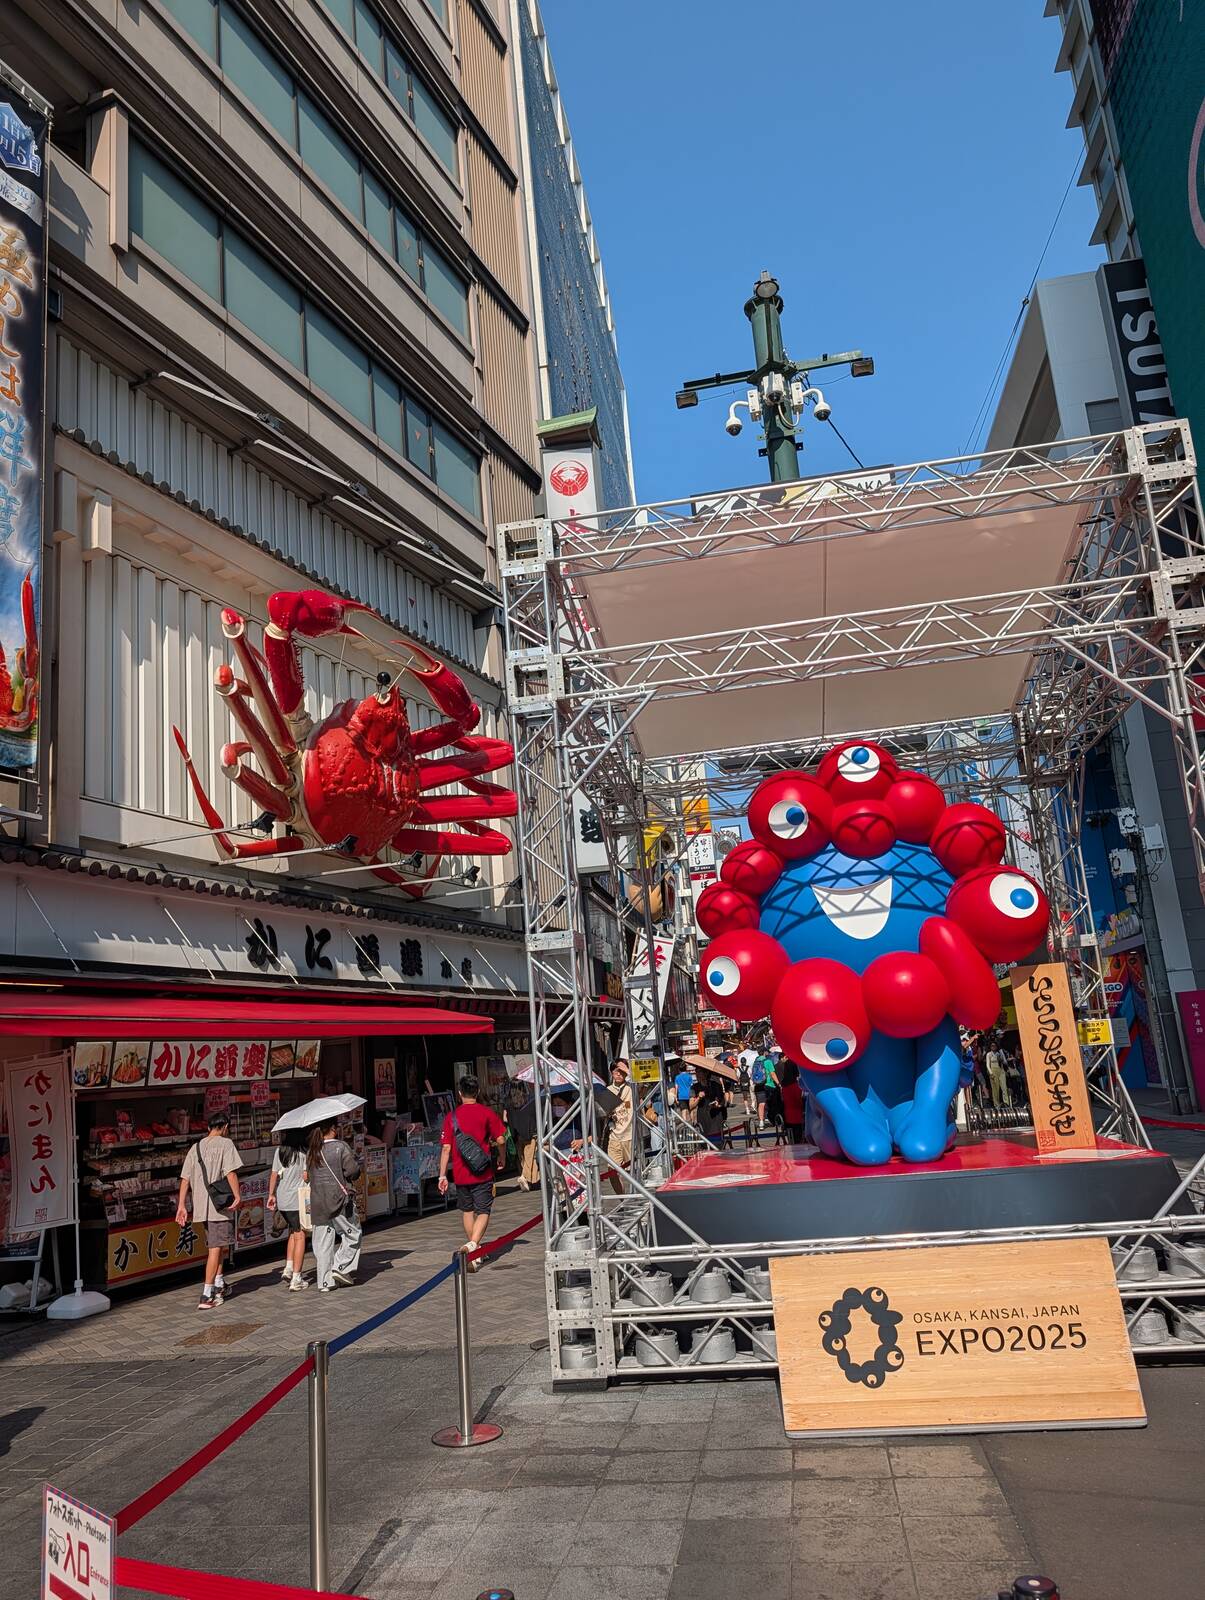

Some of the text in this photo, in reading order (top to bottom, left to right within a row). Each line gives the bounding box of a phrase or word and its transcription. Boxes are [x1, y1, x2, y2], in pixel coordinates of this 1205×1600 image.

[913, 1304, 1080, 1324] OSAKA, KANSAI, JAPAN
[915, 1322, 1087, 1356] EXPO2025
[47, 1497, 83, 1530] フォトスポット
[63, 1532, 109, 1588] 入口 Entrance
